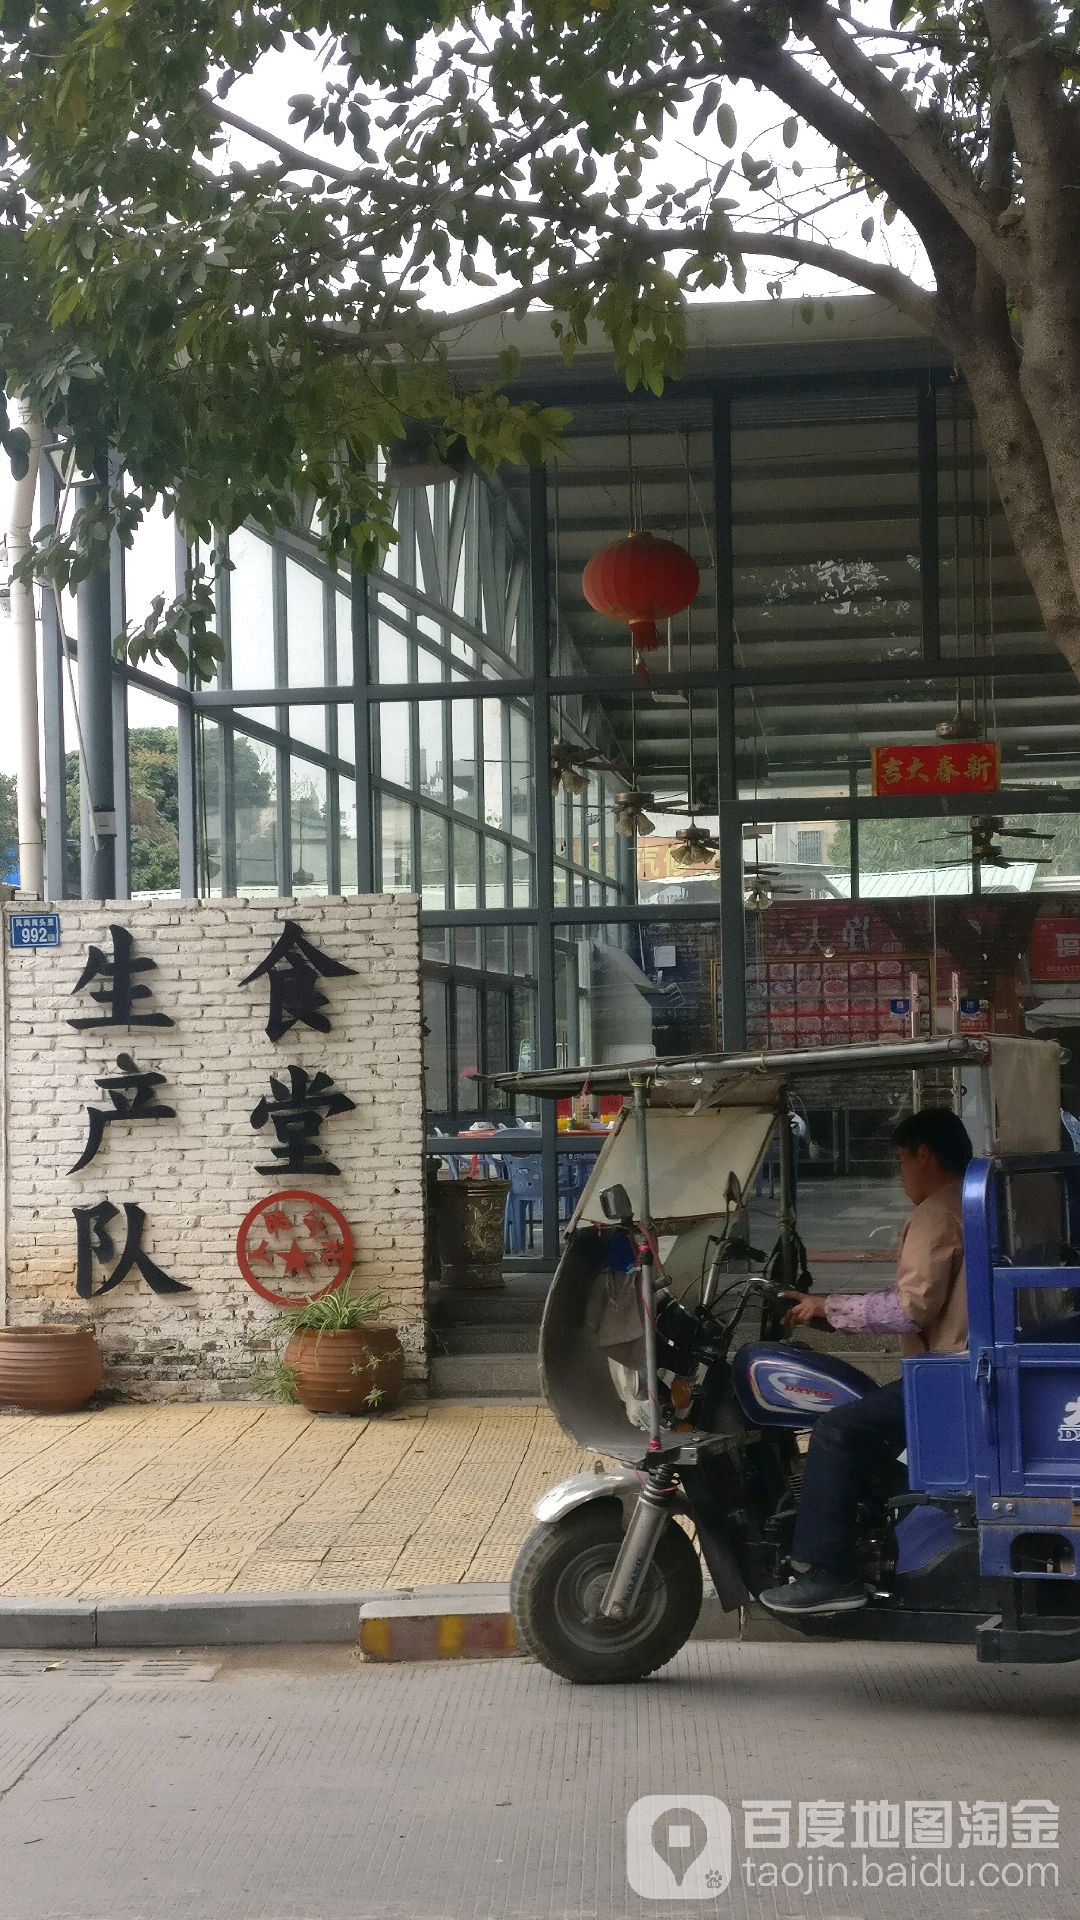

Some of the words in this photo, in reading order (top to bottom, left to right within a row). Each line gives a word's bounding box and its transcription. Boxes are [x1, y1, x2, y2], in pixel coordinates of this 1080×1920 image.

[66, 924, 193, 1299] 生产队
[237, 919, 360, 1176] 食堂
